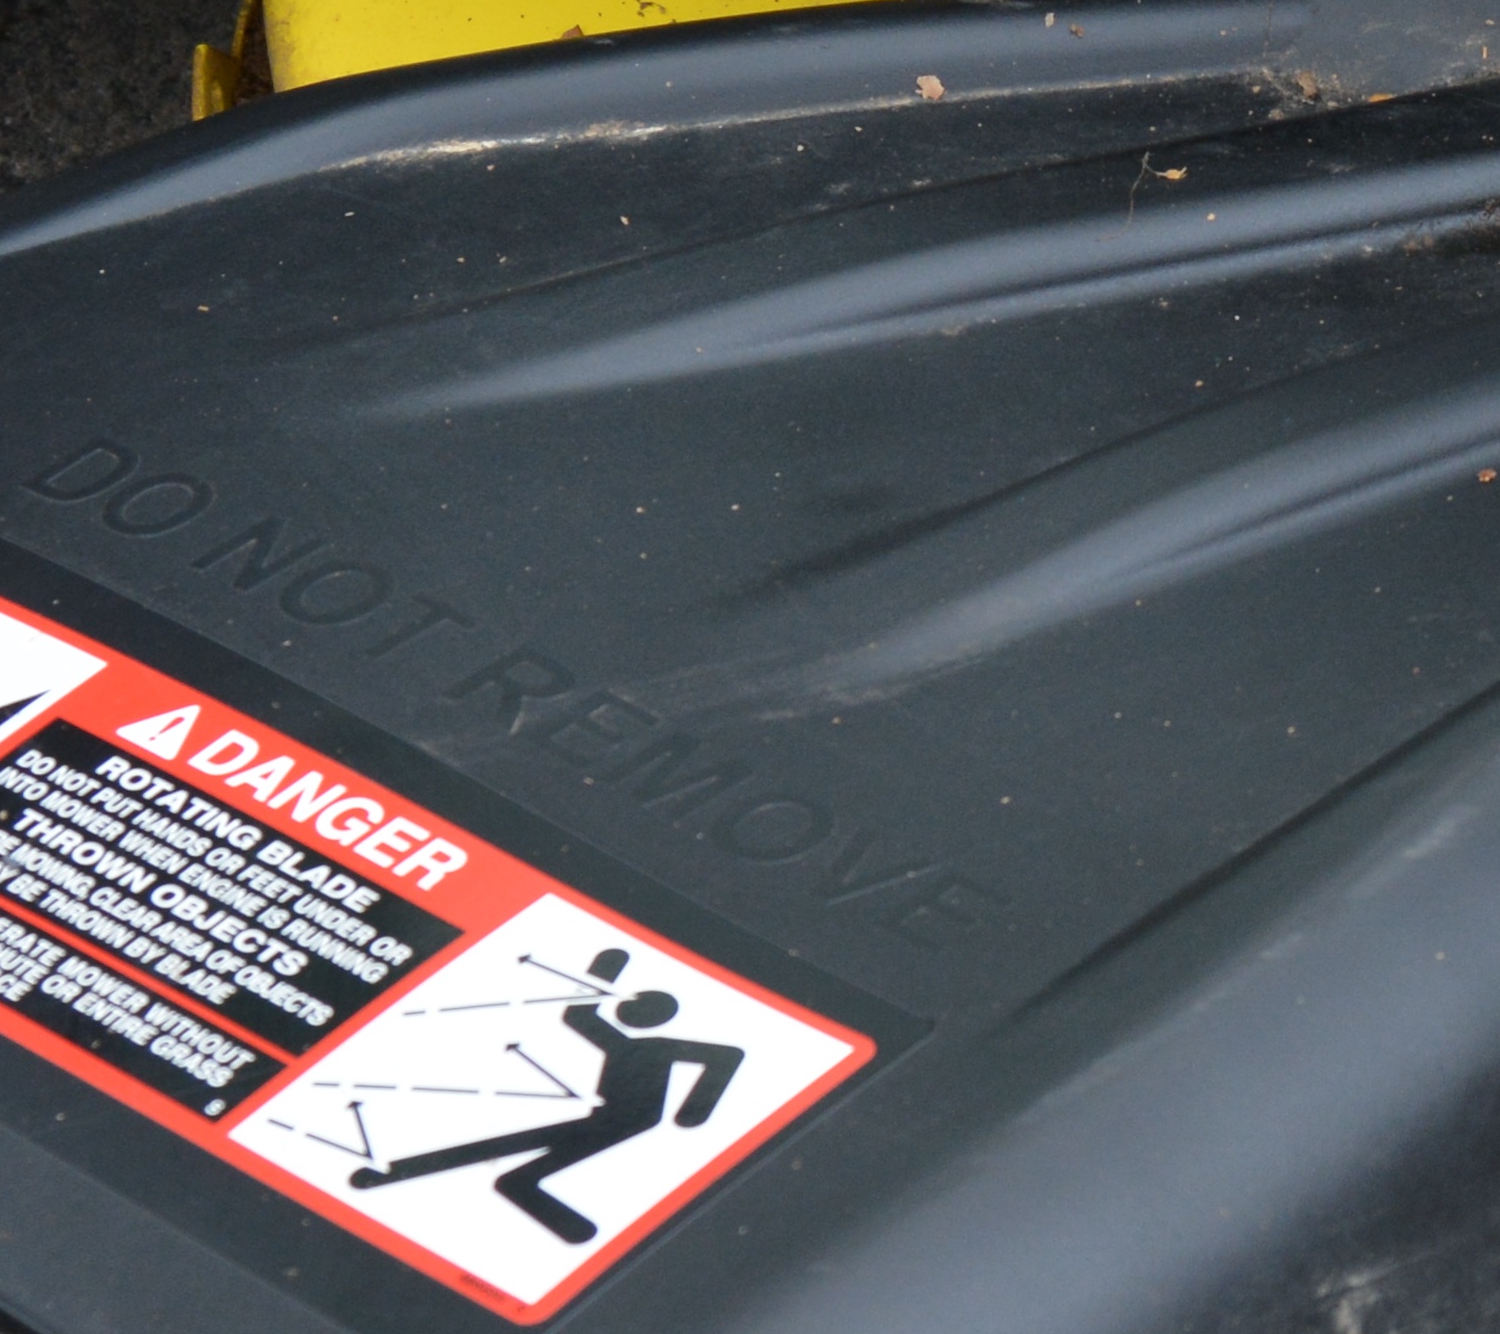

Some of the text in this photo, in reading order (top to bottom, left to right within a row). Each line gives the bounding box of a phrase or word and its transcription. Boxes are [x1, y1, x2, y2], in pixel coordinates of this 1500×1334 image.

[20, 435, 1011, 950] DO NOT REMOVE
[15, 748, 412, 965] DO NOT PUT HANDS OR FEET UNDER OR
[39, 790, 125, 841] MOWER
[118, 829, 187, 874] WHEN
[178, 862, 266, 916] ENGINE
[256, 905, 290, 929] IS
[281, 918, 387, 983] RUNNING
[95, 755, 379, 913] ROTATING BLADE
[189, 730, 467, 889] DANGER
[6, 873, 47, 901] BE
[39, 888, 134, 948] THROWN
[123, 935, 165, 963] BY
[154, 953, 235, 1004] BLADE
[13, 808, 307, 975] THROWN OBJECTS
[89, 886, 161, 932] CLEAR
[149, 921, 212, 961] AREA
[204, 949, 245, 974] OF
[233, 964, 333, 1026] OBJECTS
[40, 973, 81, 1003] OR
[72, 991, 157, 1045] ENTIRE
[149, 1034, 233, 1087] GRASS
[57, 956, 148, 1013] MOWER
[144, 1003, 256, 1069] WITHOUT
